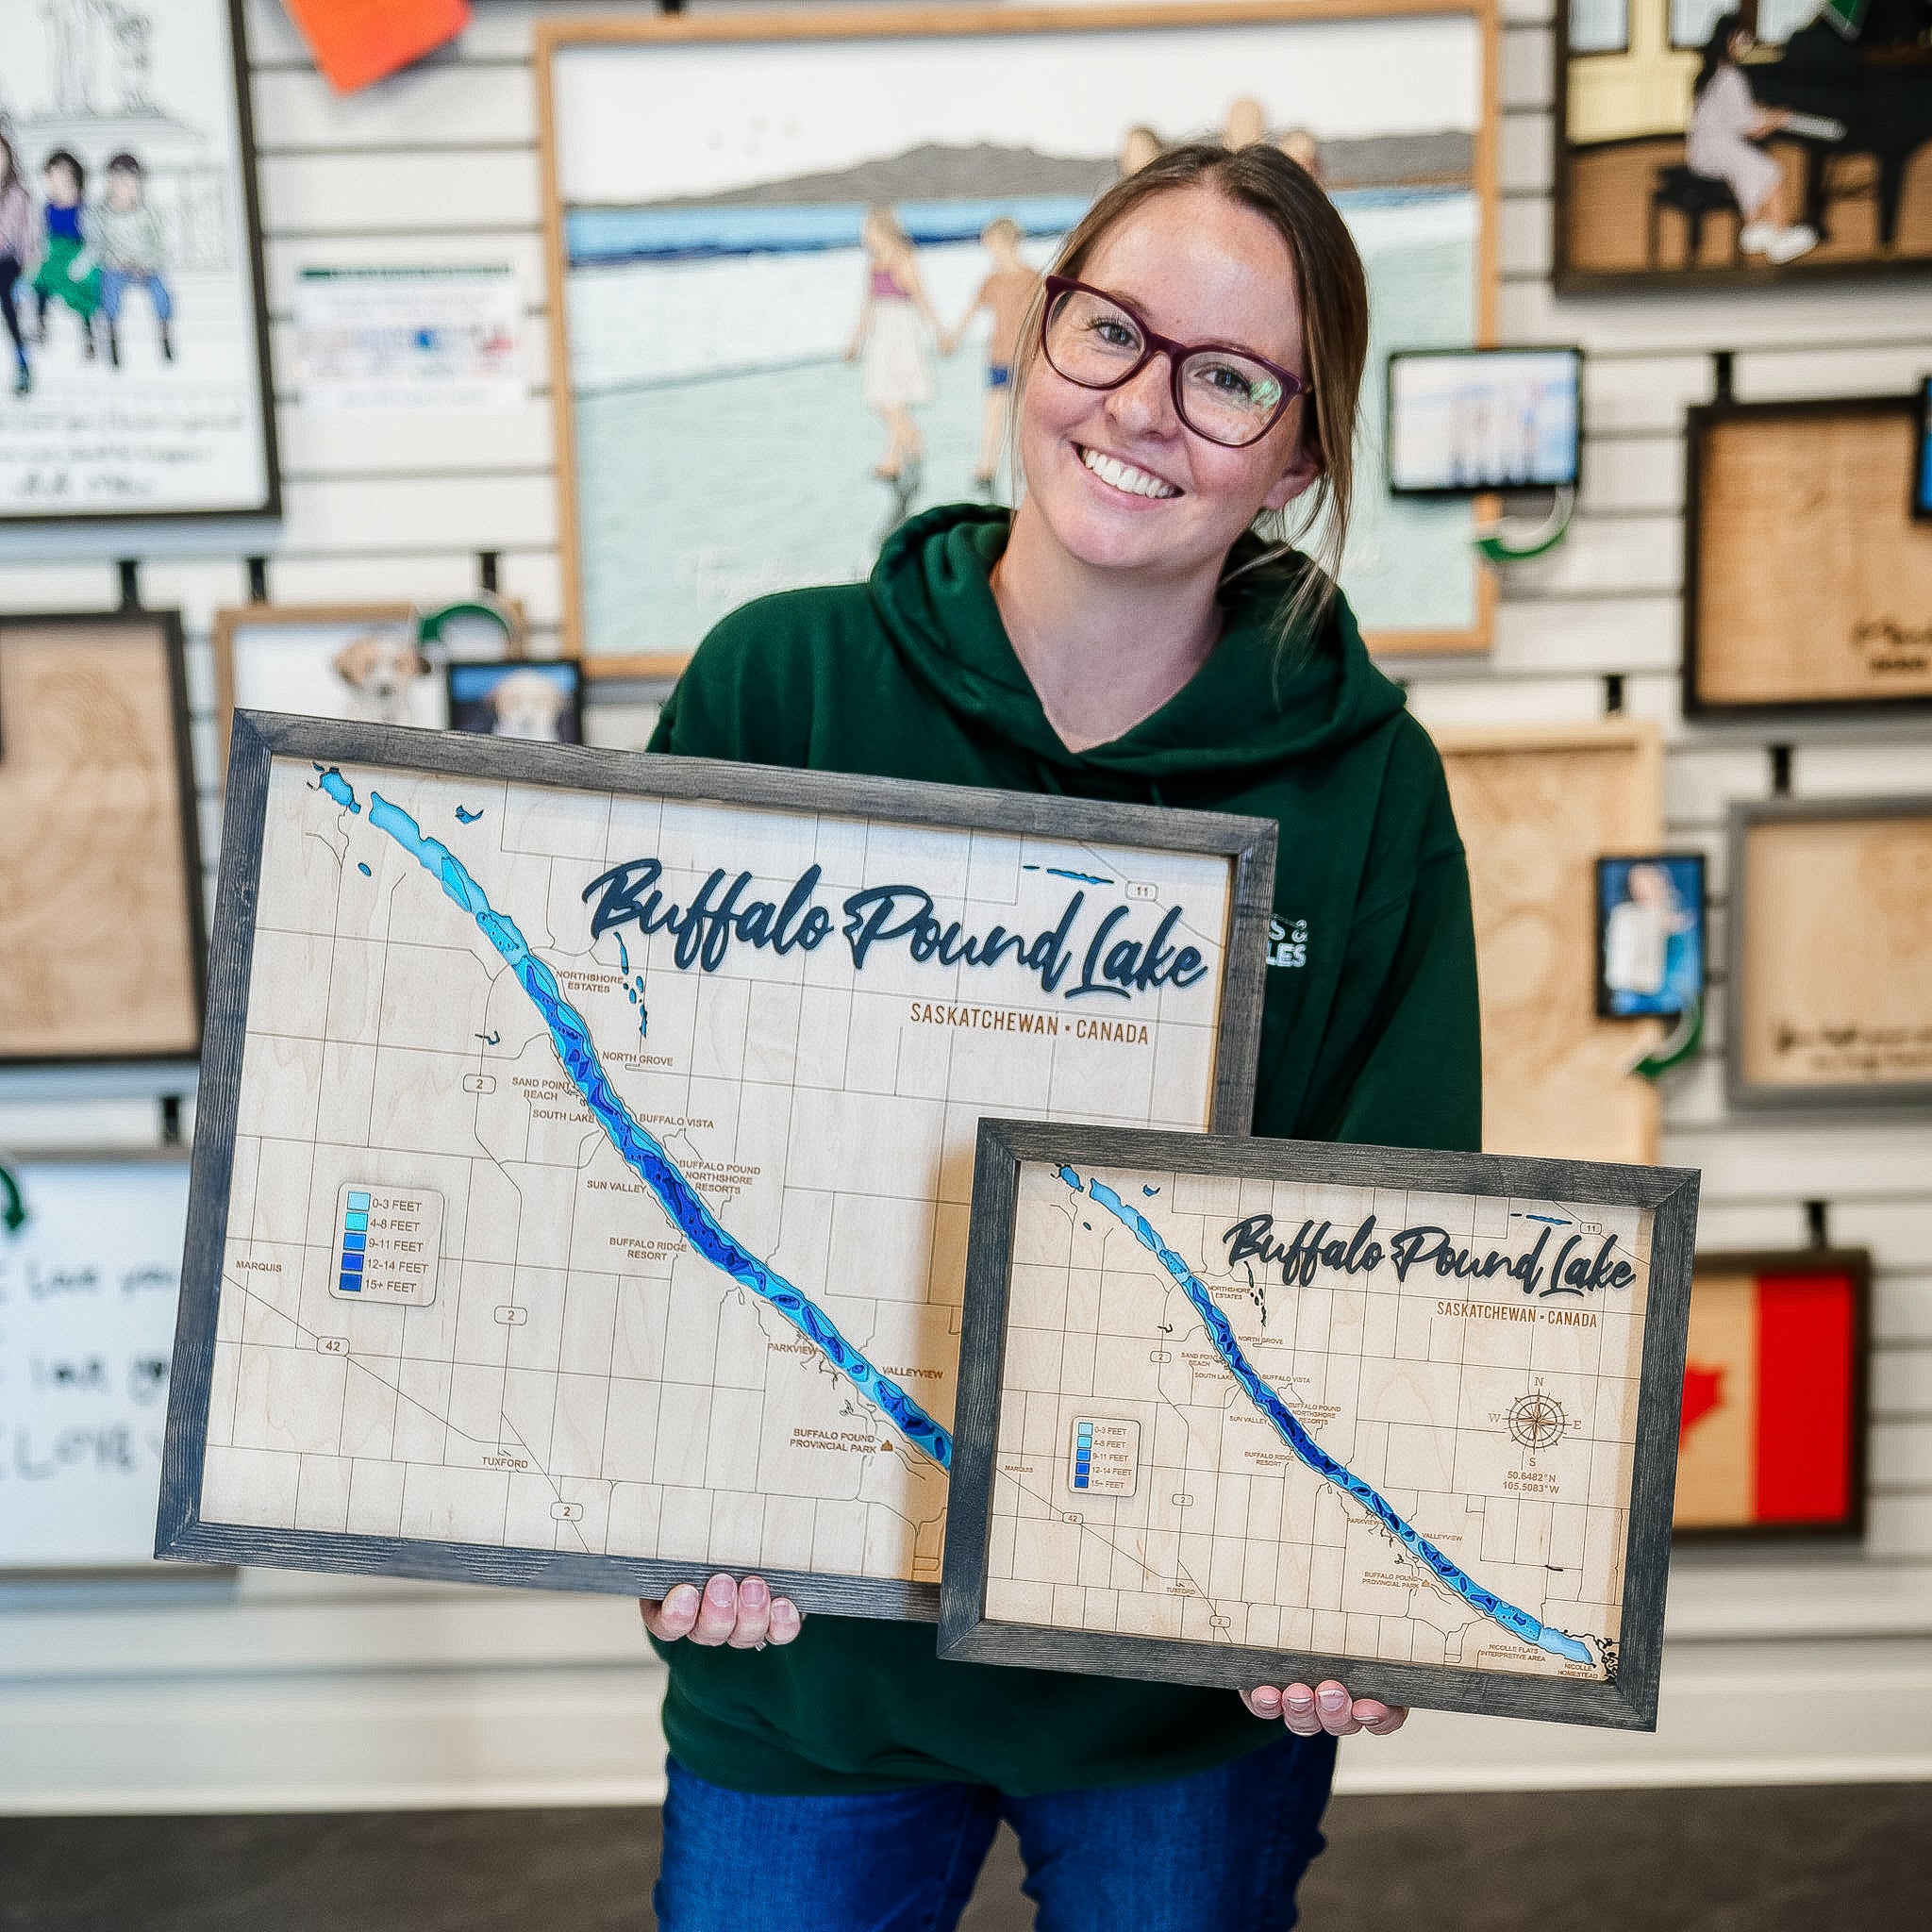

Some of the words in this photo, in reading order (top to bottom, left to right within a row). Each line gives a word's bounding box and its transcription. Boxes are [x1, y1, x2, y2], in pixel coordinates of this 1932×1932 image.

[1137, 887, 1148, 897] 11
[582, 858, 834, 973] Buffalo
[842, 885, 1085, 993] Pound
[1064, 904, 1208, 1000] Lake
[556, 970, 625, 985] NORTHSHORE
[567, 982, 610, 993] ESTATES
[910, 1003, 1058, 1037] SASKATCHEWAN
[1076, 1020, 1149, 1045] CANADA
[602, 1051, 637, 1063] NORTH
[639, 1054, 674, 1066] GROVE
[475, 1077, 484, 1090] 2
[511, 1076, 540, 1087] SAND
[541, 1080, 571, 1091] POINT
[523, 1090, 558, 1101] BEACH
[532, 1108, 567, 1121] SOUTH
[569, 1112, 595, 1124] LAKE
[639, 1113, 685, 1126] BUFFALO
[687, 1118, 714, 1129] VISTA
[678, 1159, 724, 1172] BUFFALO
[726, 1164, 761, 1175] POUND
[685, 1171, 753, 1186] NORTHSHORE
[586, 1179, 608, 1190] SUN
[608, 1182, 647, 1194] VALLEY
[694, 1182, 741, 1195] RESORTS
[372, 1198, 390, 1209] 0-3
[391, 1199, 423, 1213] FEET
[369, 1218, 388, 1229] 4-8
[390, 1219, 422, 1233] FEET
[1586, 1224, 1596, 1233] 11
[368, 1238, 391, 1248] 9-11
[393, 1240, 425, 1253] FEET
[608, 1237, 655, 1249] BUFFALO
[657, 1241, 688, 1253] RIDGE
[626, 1249, 668, 1261] RESORT
[1223, 1214, 1385, 1288] Buffalo
[1390, 1225, 1551, 1295] Pound
[1538, 1234, 1637, 1299] Lake
[235, 1258, 283, 1274] MARQUIS
[367, 1257, 396, 1272] 12-14
[398, 1260, 430, 1274] FEET
[365, 1278, 384, 1291] 15+
[386, 1280, 417, 1293] FEET
[1208, 1286, 1251, 1295] NORTHSHORE
[507, 1309, 515, 1322] 2
[1437, 1301, 1537, 1323] SASKATCHEWAN
[1547, 1310, 1597, 1328] CANADA
[325, 1341, 341, 1353] 42
[767, 1341, 819, 1357] PARKVIEW
[881, 1364, 944, 1381] VALLEYVIEW
[1194, 1372, 1217, 1380] SOUTH
[1261, 1374, 1291, 1382] BUFFALO
[1535, 1376, 1545, 1387] N
[1288, 1402, 1318, 1410] BUFFALO
[1243, 1416, 1269, 1424] VALLEY
[1298, 1417, 1329, 1425] RESORTS
[1488, 1412, 1502, 1423] W
[1574, 1420, 1583, 1430] E
[793, 1427, 839, 1441] BUFFALO
[841, 1432, 875, 1443] POUND
[1094, 1425, 1107, 1434] 0-3
[1108, 1427, 1128, 1436] FEET
[790, 1438, 847, 1452] PROVINCIAL
[850, 1443, 877, 1454] PARK
[1106, 1441, 1127, 1449] FEET
[1092, 1453, 1108, 1461] 9-11
[1108, 1454, 1129, 1462] FEET
[1244, 1451, 1274, 1459] BUFFALO
[481, 1456, 529, 1470] TUXFORD
[1528, 1457, 1537, 1467] S
[1004, 1464, 1034, 1474] MARQUIS
[1091, 1466, 1111, 1474] 12-14
[1112, 1468, 1133, 1476] FEET
[1106, 1481, 1125, 1490] FEET
[562, 1506, 571, 1518] 2
[1067, 1514, 1078, 1524] 42
[1347, 1517, 1380, 1526] PARKVIEW
[1421, 1532, 1463, 1542] VALLEYVIEW
[1364, 1572, 1394, 1580] BUFFALO
[1395, 1574, 1419, 1583] POUND
[1362, 1578, 1401, 1589] PROVINCIAL
[1402, 1581, 1420, 1590] PARK
[1166, 1587, 1196, 1596] TUXFORD
[1489, 1643, 1518, 1653] NICOLLE
[1518, 1646, 1540, 1655] FLATS
[1527, 1655, 1547, 1663] AREA
[1564, 1663, 1593, 1672] NICOLLE
[1557, 1670, 1599, 1680] HOMESTEAD
